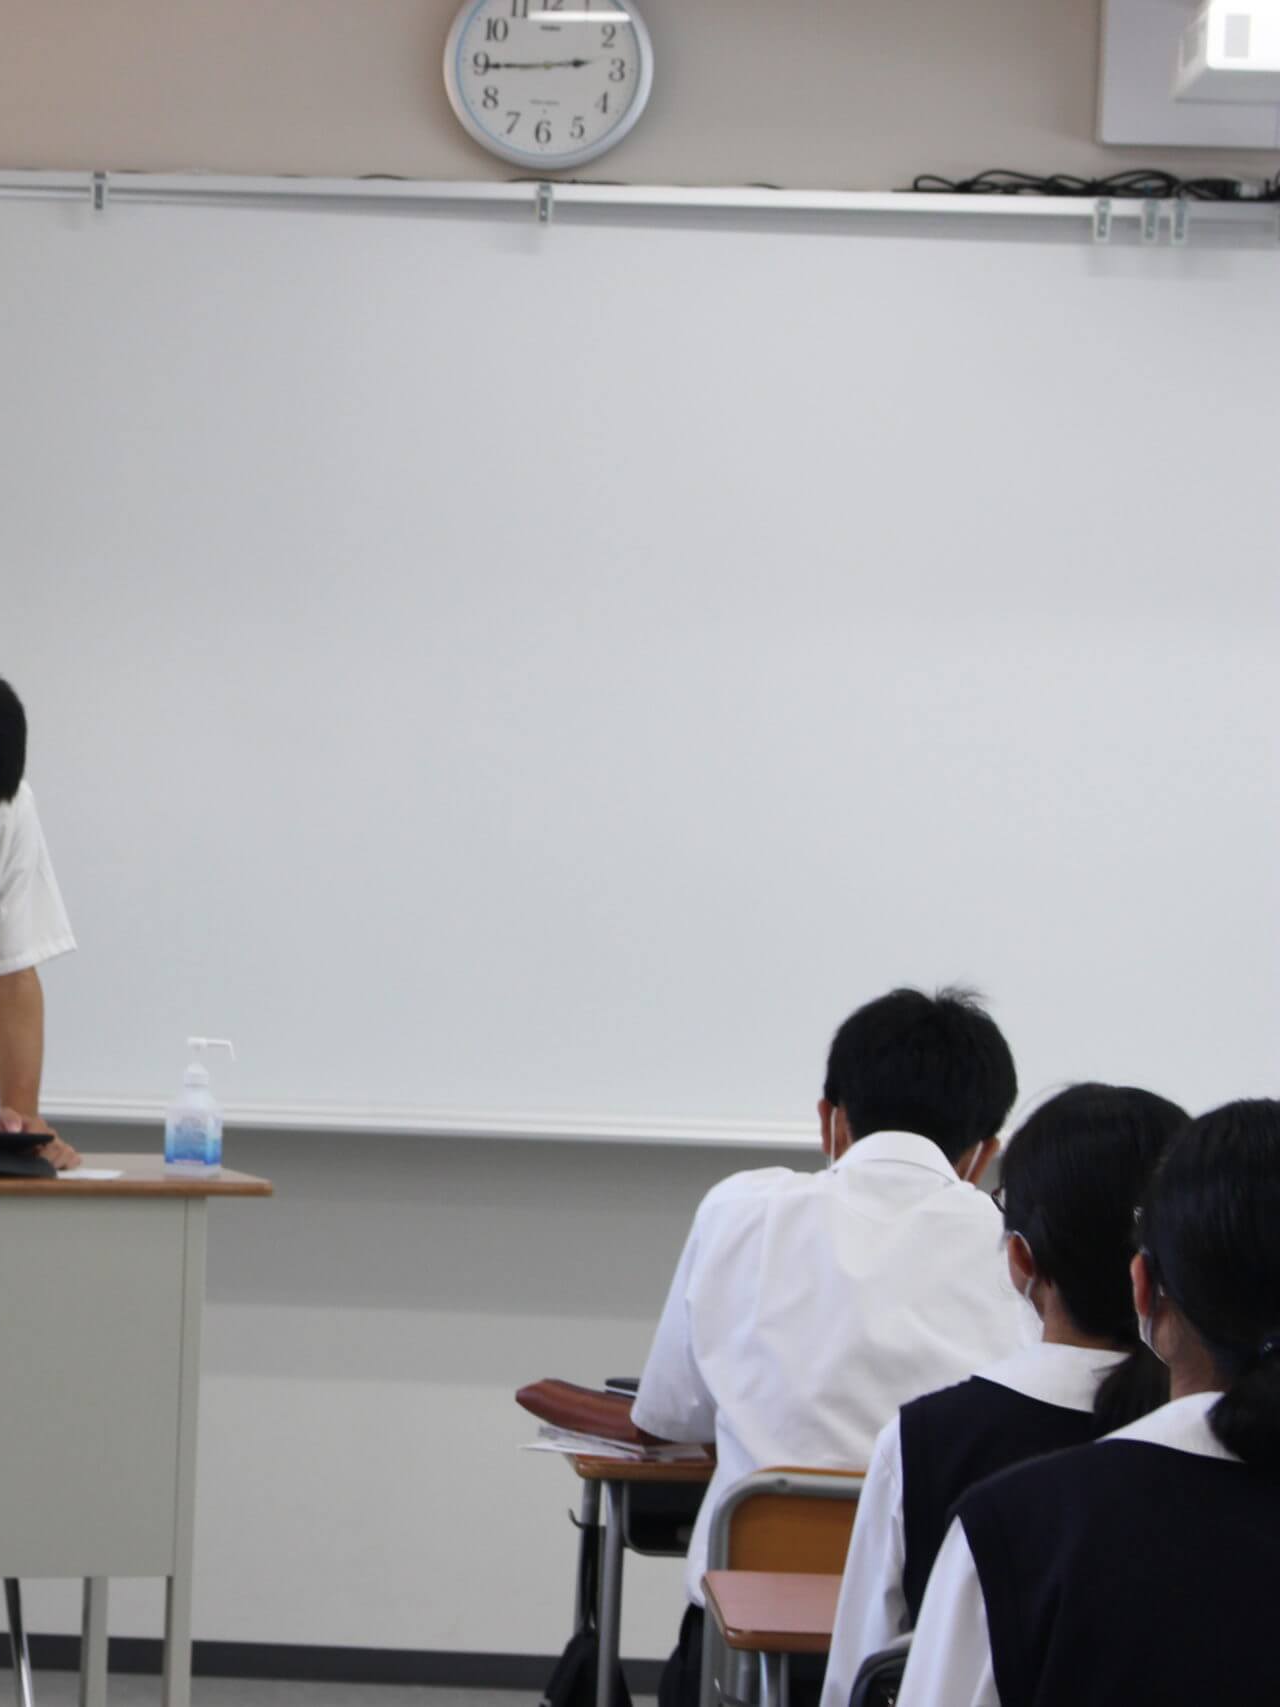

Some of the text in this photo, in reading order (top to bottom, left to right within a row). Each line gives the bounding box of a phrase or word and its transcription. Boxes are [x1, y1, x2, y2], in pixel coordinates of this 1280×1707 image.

[511, 0, 528, 18] 11
[485, 18, 508, 42] 10
[601, 24, 616, 48] 2
[473, 51, 490, 76] 9
[609, 58, 625, 82] 3
[482, 86, 498, 109] 8
[595, 91, 608, 114] 4
[505, 111, 521, 135] 7
[534, 120, 552, 144] 6
[570, 116, 585, 139] 5
